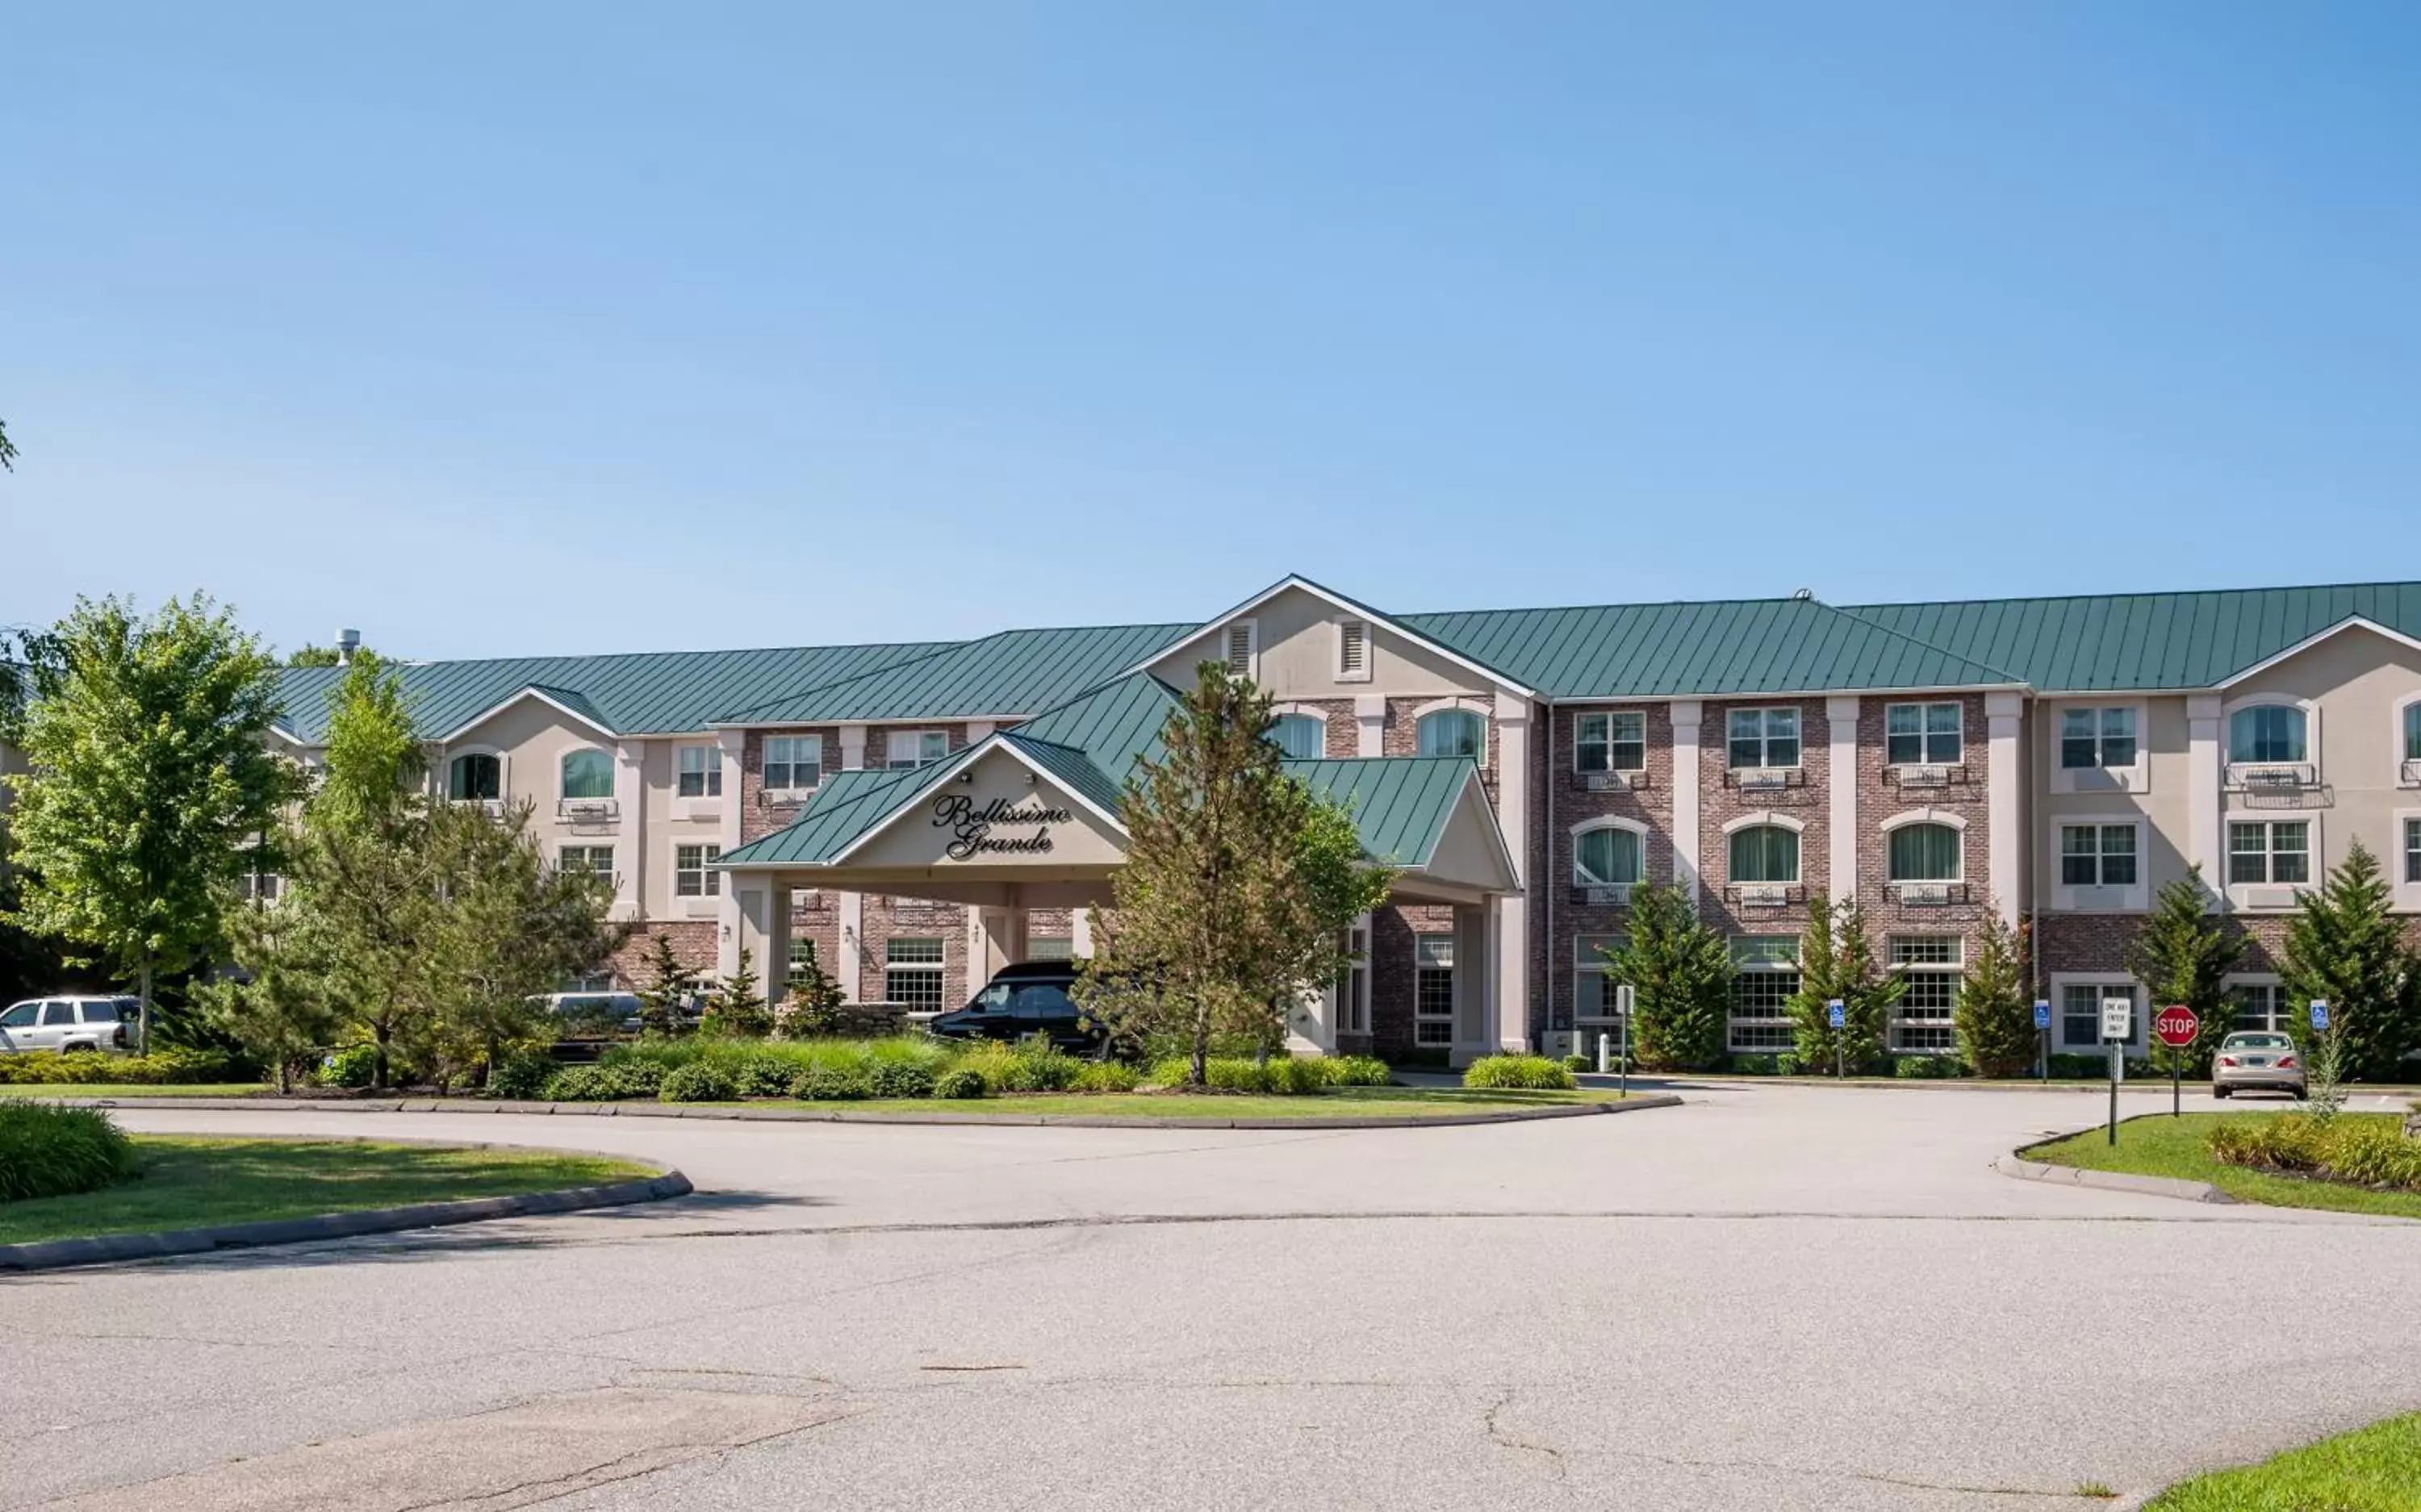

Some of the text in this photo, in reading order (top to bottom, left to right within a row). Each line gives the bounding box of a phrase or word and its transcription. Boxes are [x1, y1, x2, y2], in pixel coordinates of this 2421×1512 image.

[933, 795, 1073, 827] Bellissimo
[947, 824, 1052, 859] Grande
[2159, 1018, 2194, 1034] STOP
